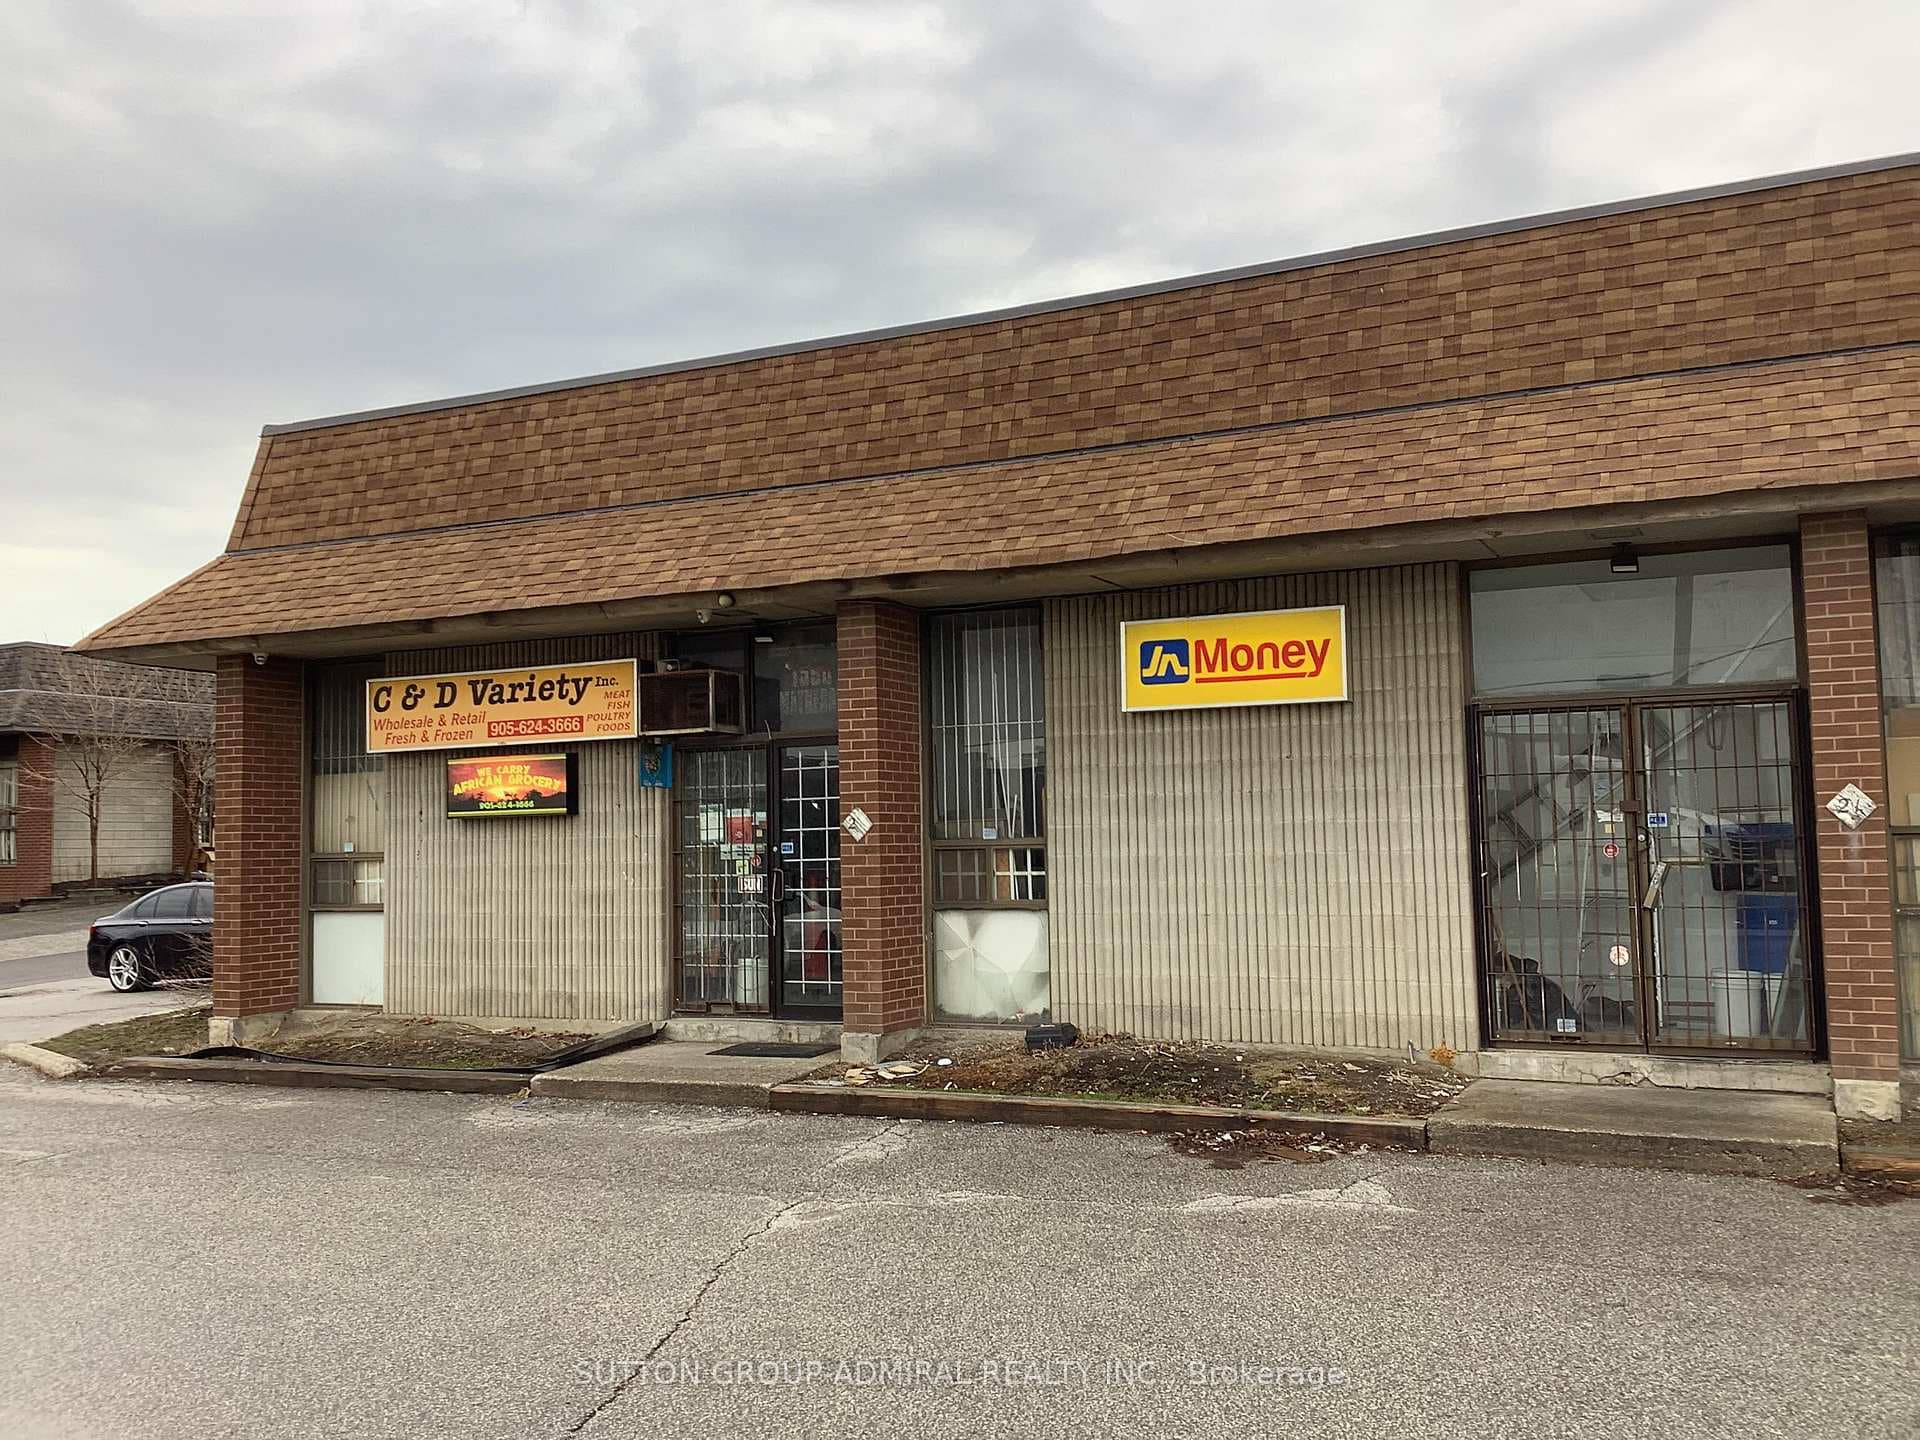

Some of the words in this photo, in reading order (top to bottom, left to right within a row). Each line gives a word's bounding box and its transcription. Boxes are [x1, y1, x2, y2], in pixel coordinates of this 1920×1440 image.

[1194, 638, 1332, 678] Money
[595, 676, 619, 687] Inc.
[373, 686, 392, 712] C
[401, 684, 425, 710] &
[433, 682, 457, 708] D
[467, 673, 593, 706] Variety
[604, 690, 631, 699] MEAT
[607, 701, 631, 710] FISH
[374, 715, 434, 731] Wholesale
[438, 714, 447, 726] &
[451, 711, 486, 726] Retail
[586, 711, 631, 722] POULTRY
[490, 717, 581, 736] 905-624-3666
[596, 722, 631, 732] FOODS
[385, 731, 416, 745] Fresh
[420, 730, 430, 743] &
[434, 729, 473, 742] Frozen
[477, 767, 492, 776] WE
[497, 765, 530, 775] CARRY
[453, 776, 502, 796] AFRICAN
[508, 774, 562, 790] GROCERY
